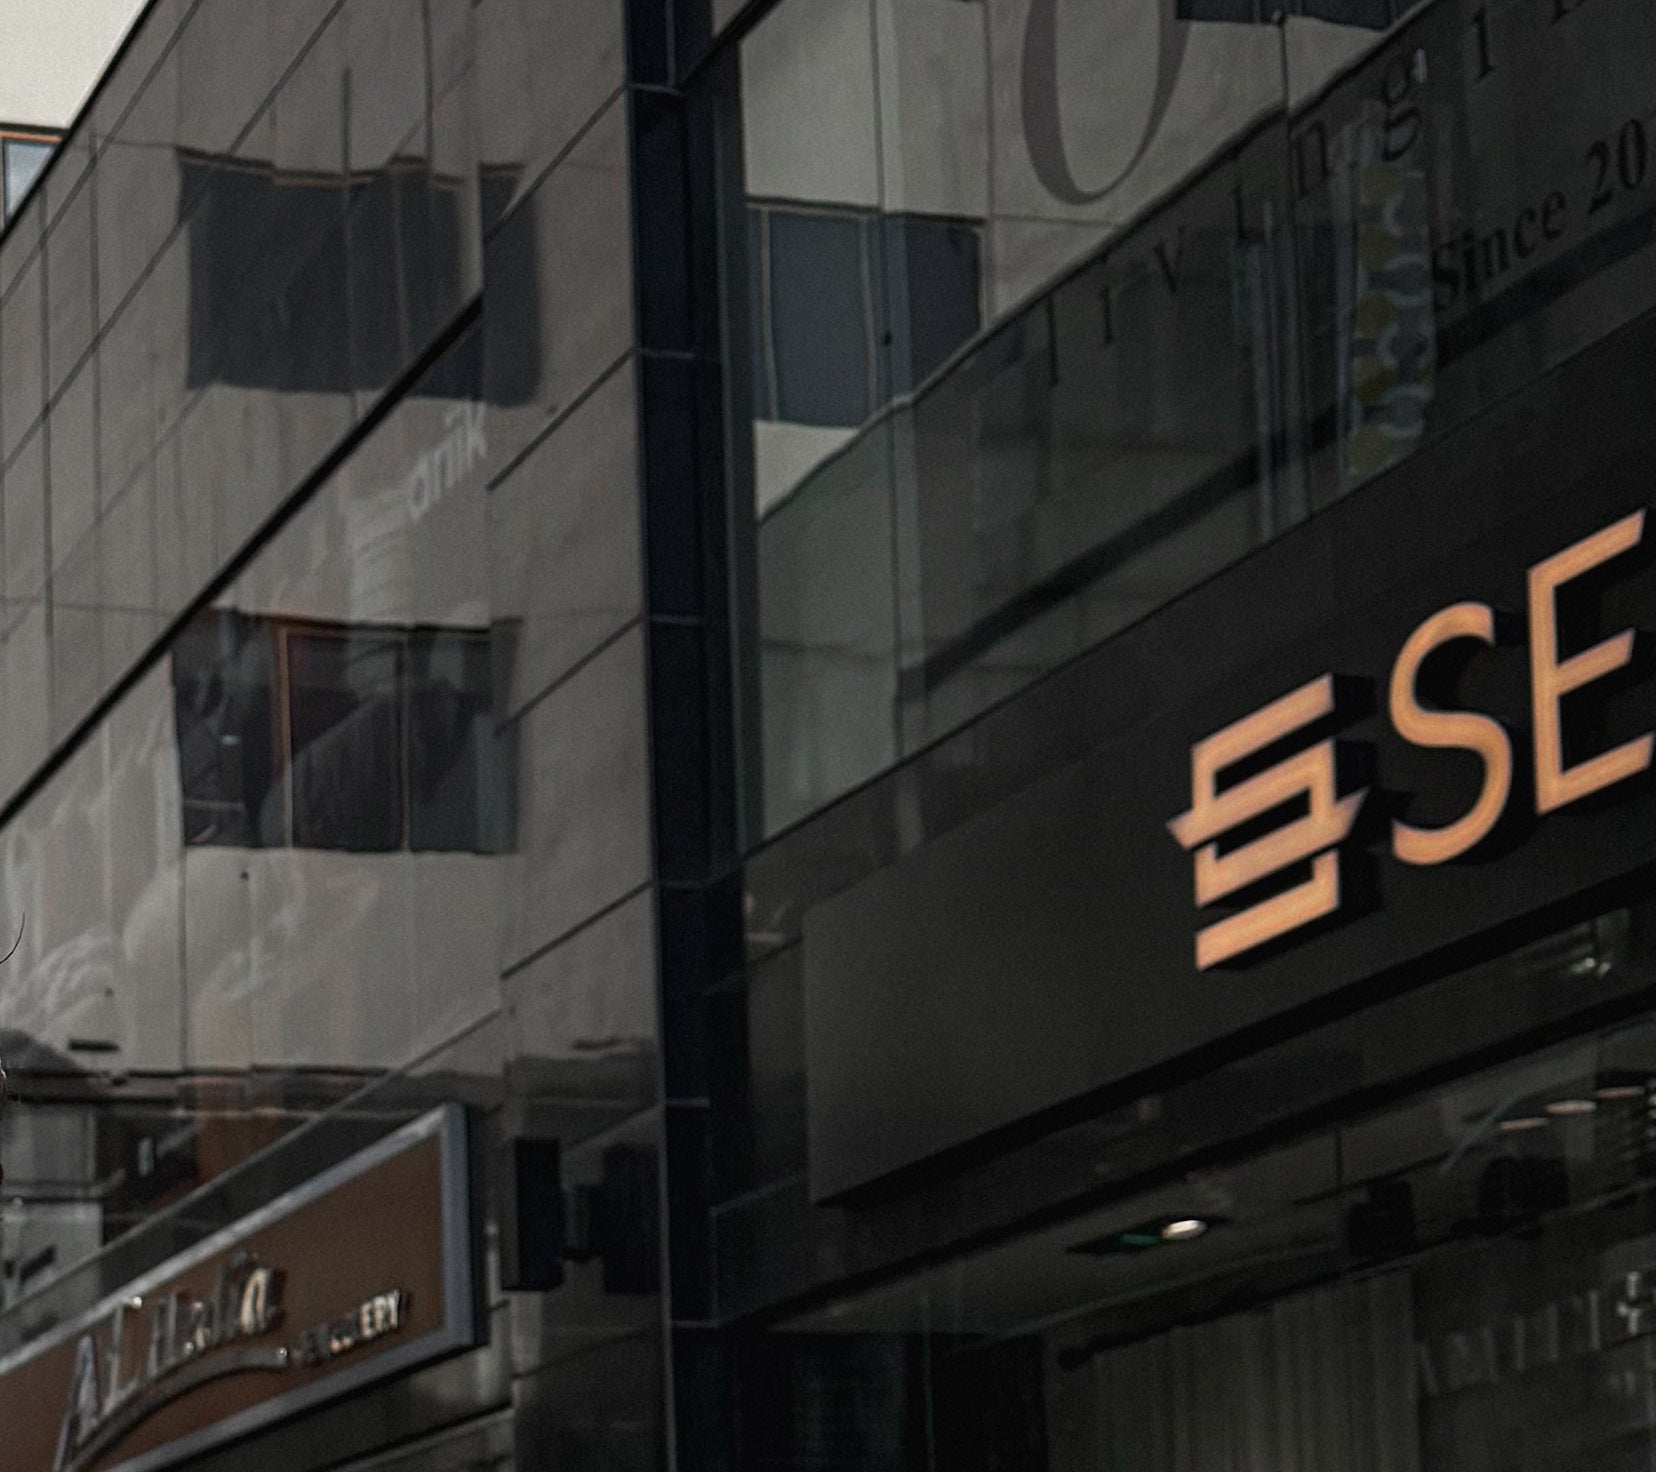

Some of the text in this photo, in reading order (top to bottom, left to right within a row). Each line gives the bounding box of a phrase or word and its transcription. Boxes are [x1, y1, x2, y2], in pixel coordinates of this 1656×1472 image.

[1430, 117, 1656, 312] Since 20
[1388, 508, 1656, 867] SE
